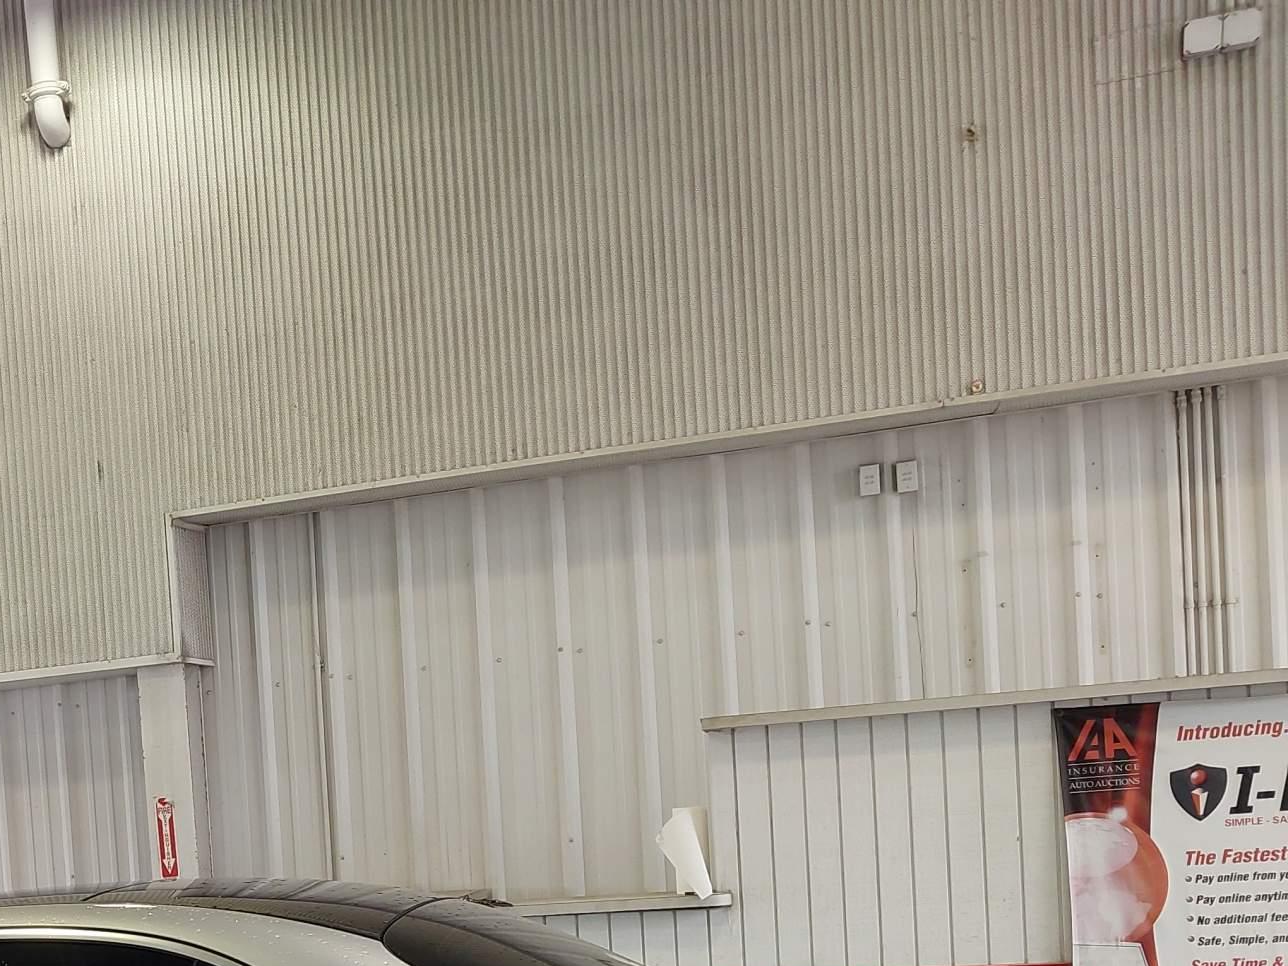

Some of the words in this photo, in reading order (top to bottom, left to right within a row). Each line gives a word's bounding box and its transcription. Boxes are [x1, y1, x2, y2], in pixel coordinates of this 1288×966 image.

[1068, 763, 1140, 776] INSURANCE
[1069, 780, 1095, 789] AUTO
[1095, 776, 1141, 787] AUCTIONS
[1225, 816, 1263, 827] SIMPLE
[1186, 850, 1216, 865] The
[1222, 846, 1288, 864] Fastest
[1195, 874, 1214, 885] Pay
[1217, 872, 1249, 883] online
[1253, 871, 1276, 880] from
[1196, 894, 1216, 906] Pay
[1218, 893, 1252, 903] online
[1197, 915, 1211, 925] No
[1213, 912, 1268, 925] additional
[1197, 936, 1225, 947] Safe,
